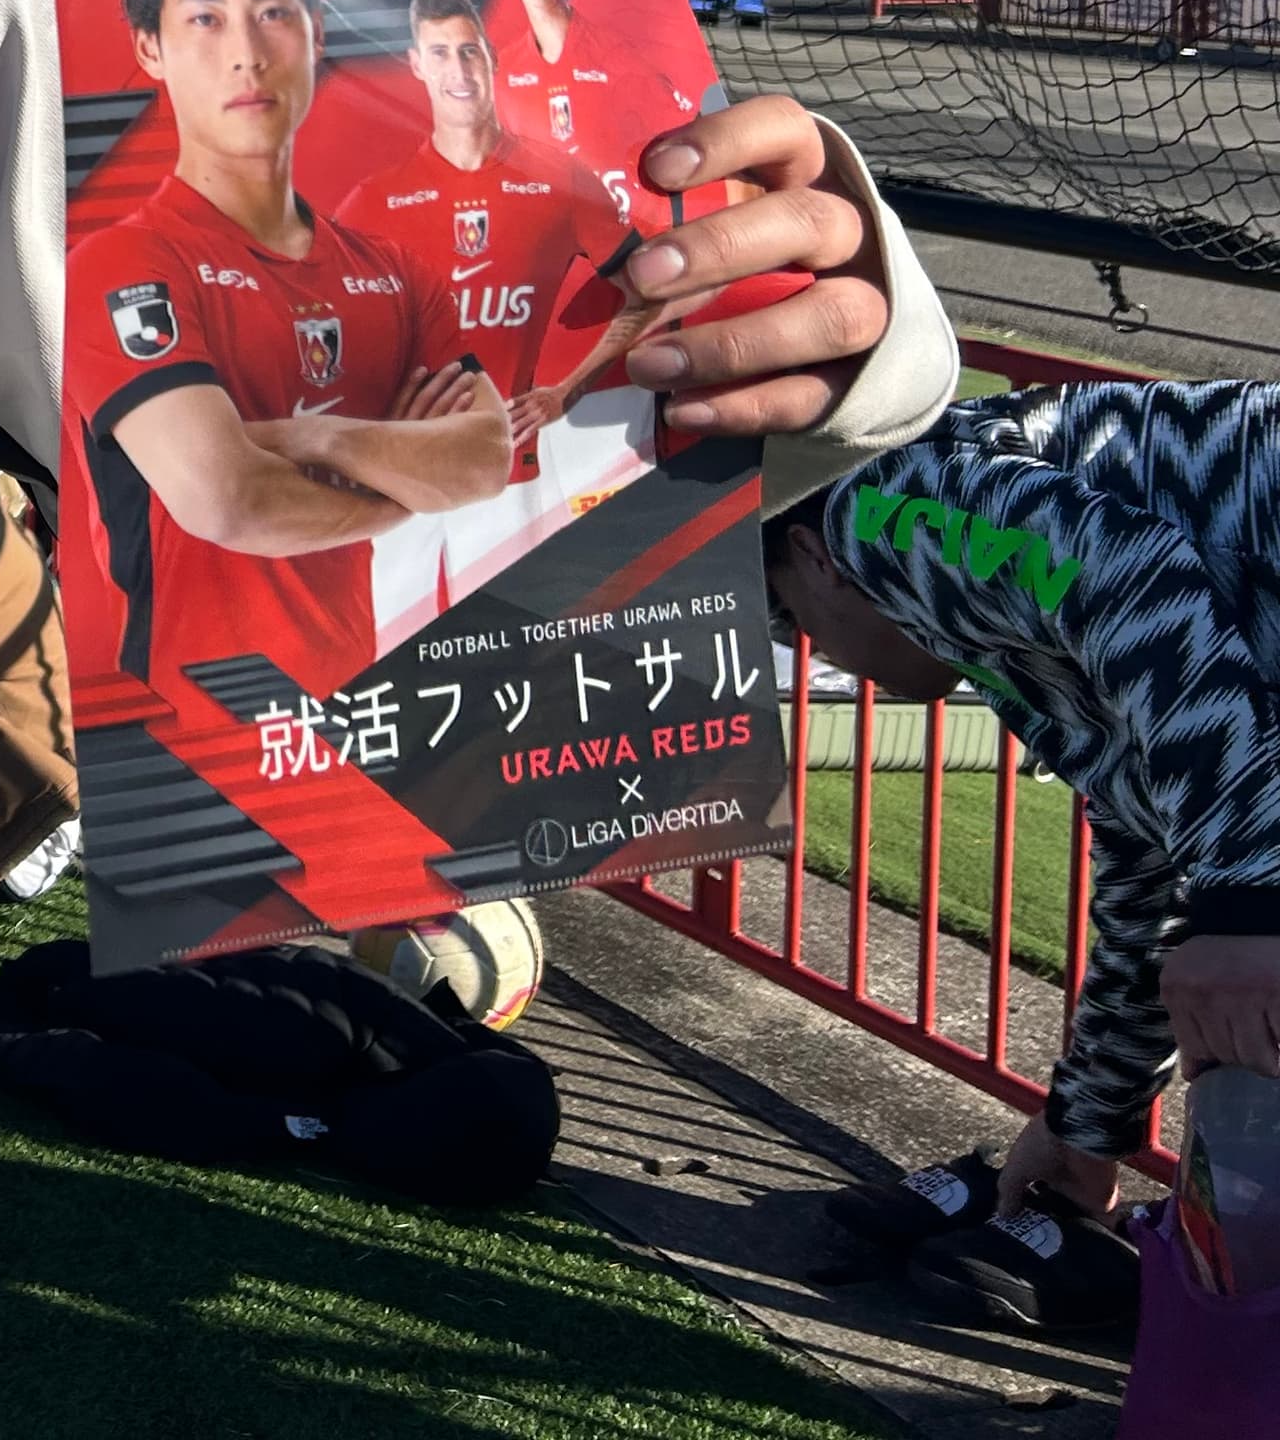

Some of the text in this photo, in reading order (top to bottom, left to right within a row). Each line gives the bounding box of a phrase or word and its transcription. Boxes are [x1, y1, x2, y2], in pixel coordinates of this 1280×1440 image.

[450, 284, 536, 330] LUS
[854, 484, 1082, 613] NAIJA
[418, 591, 738, 662] FOOTBALL TOGETHER URAWA REDS
[254, 627, 760, 782] 就活フットサル
[500, 714, 752, 785] URAWA REDS
